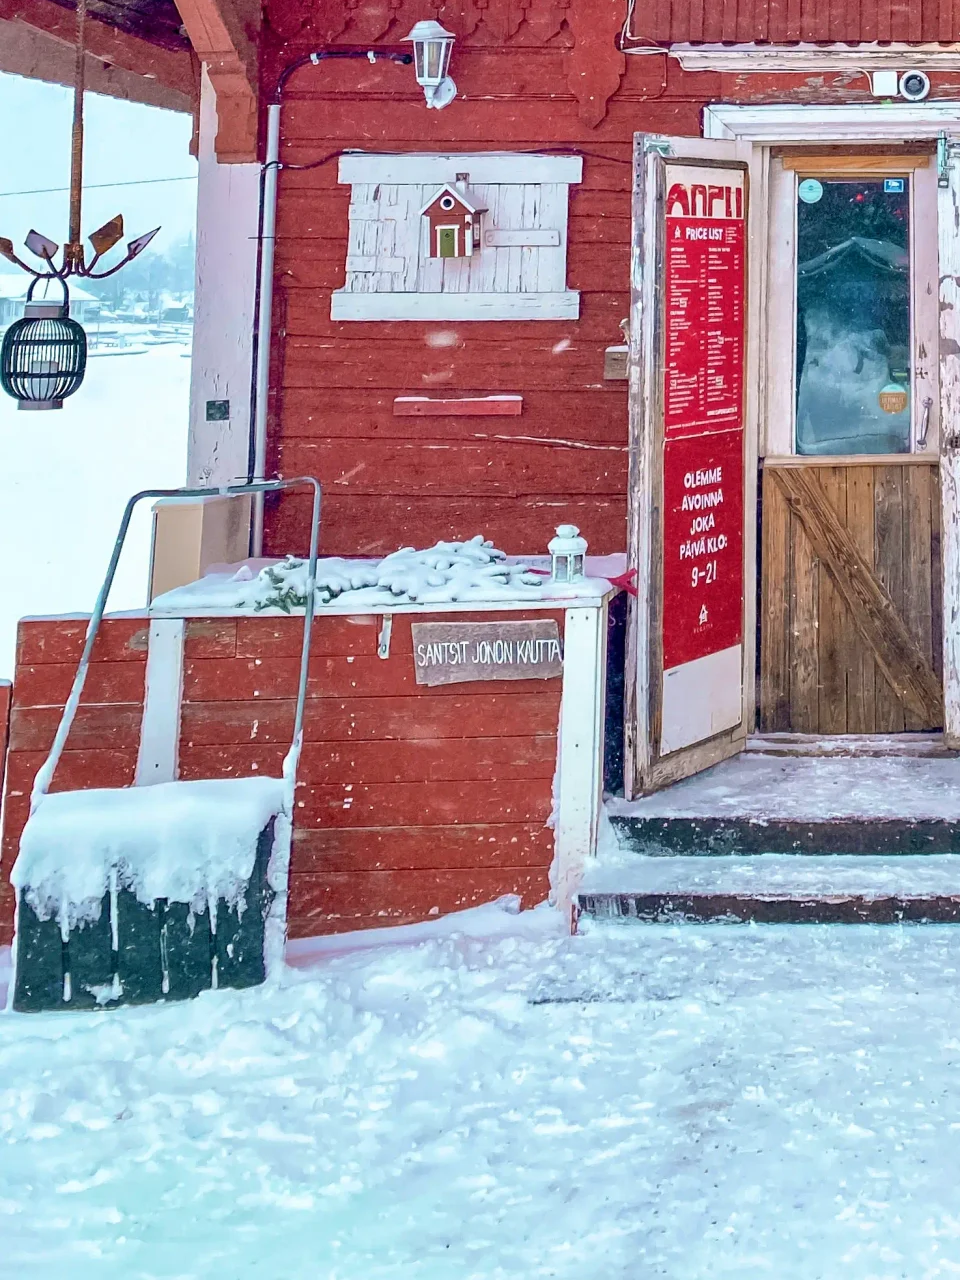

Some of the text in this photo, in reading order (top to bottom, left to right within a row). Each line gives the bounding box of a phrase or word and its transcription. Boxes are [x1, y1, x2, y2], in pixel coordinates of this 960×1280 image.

[685, 227, 708, 241] PRICE
[708, 228, 723, 241] LIST
[683, 467, 722, 489] OLEMME
[681, 489, 724, 511] AVOINNA
[690, 513, 715, 535] JOKA
[679, 534, 728, 560] PÄIVÄ KLO:
[417, 639, 565, 667] SANTSIT JONON KAUTTA
